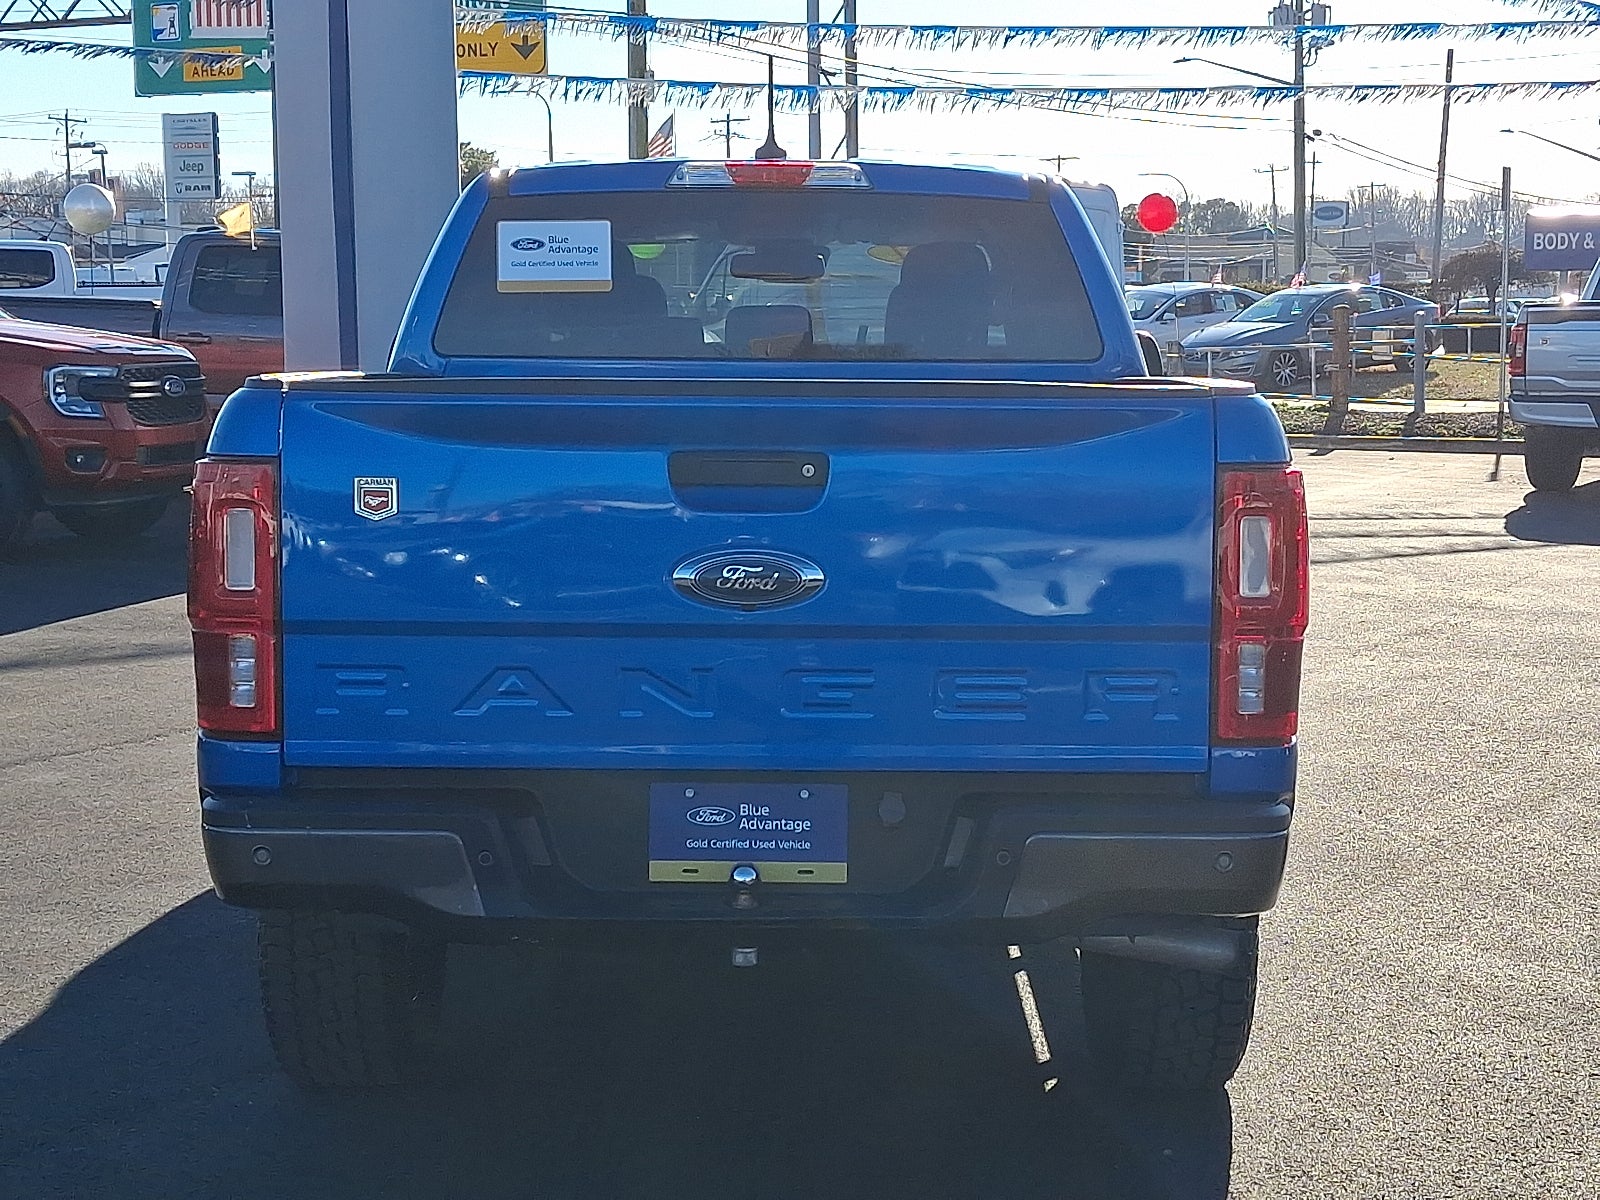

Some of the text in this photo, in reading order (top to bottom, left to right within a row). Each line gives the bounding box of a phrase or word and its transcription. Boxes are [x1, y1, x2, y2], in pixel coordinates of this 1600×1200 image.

[456, 41, 499, 58] ONLY
[192, 65, 235, 78] AHEAD
[179, 160, 204, 174] Jeep
[184, 184, 212, 192] RAM
[548, 235, 569, 244] Blue
[1533, 231, 1595, 250] BODY &
[547, 245, 599, 255] Advantage
[359, 478, 394, 486] CARMAN
[716, 565, 780, 591] Ford
[315, 663, 1182, 721] RANGER
[695, 807, 727, 823] Ford
[739, 803, 770, 816] Blue
[739, 817, 812, 833] Advantage
[686, 838, 811, 850] Gold Certified Used Vehicle
